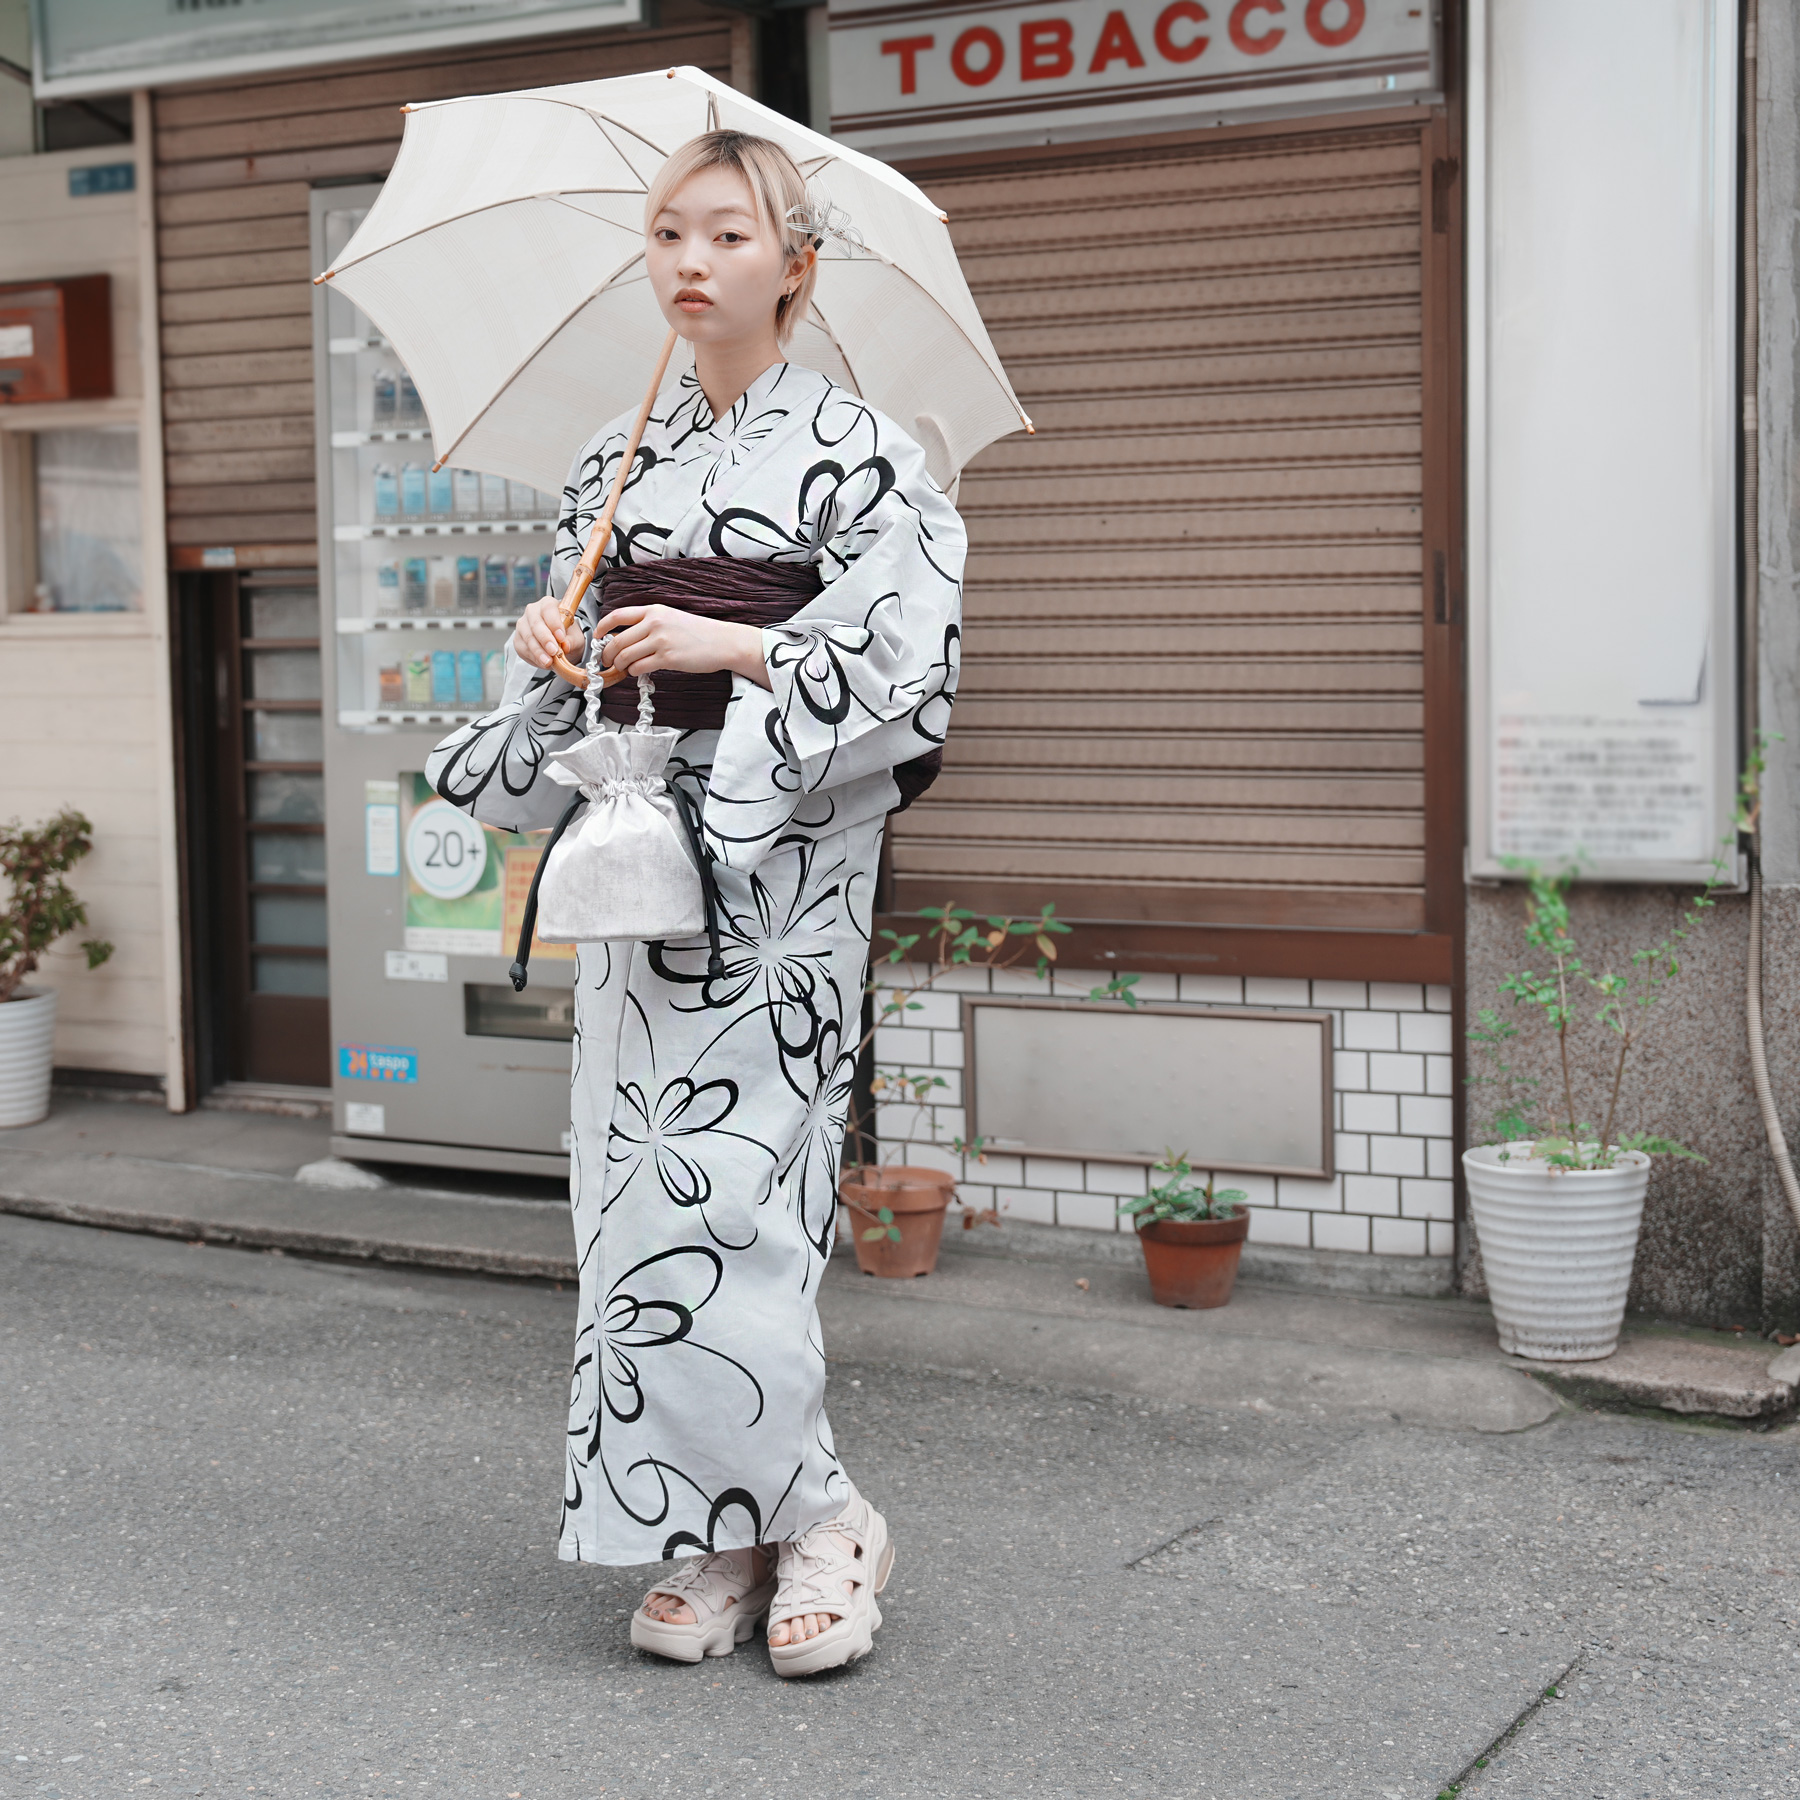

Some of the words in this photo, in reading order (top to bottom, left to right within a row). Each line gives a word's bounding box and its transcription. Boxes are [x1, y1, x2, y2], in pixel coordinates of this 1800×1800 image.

[881, 0, 1366, 95] TOBACCO
[423, 831, 482, 867] 20+
[369, 1053, 409, 1070] taspo
